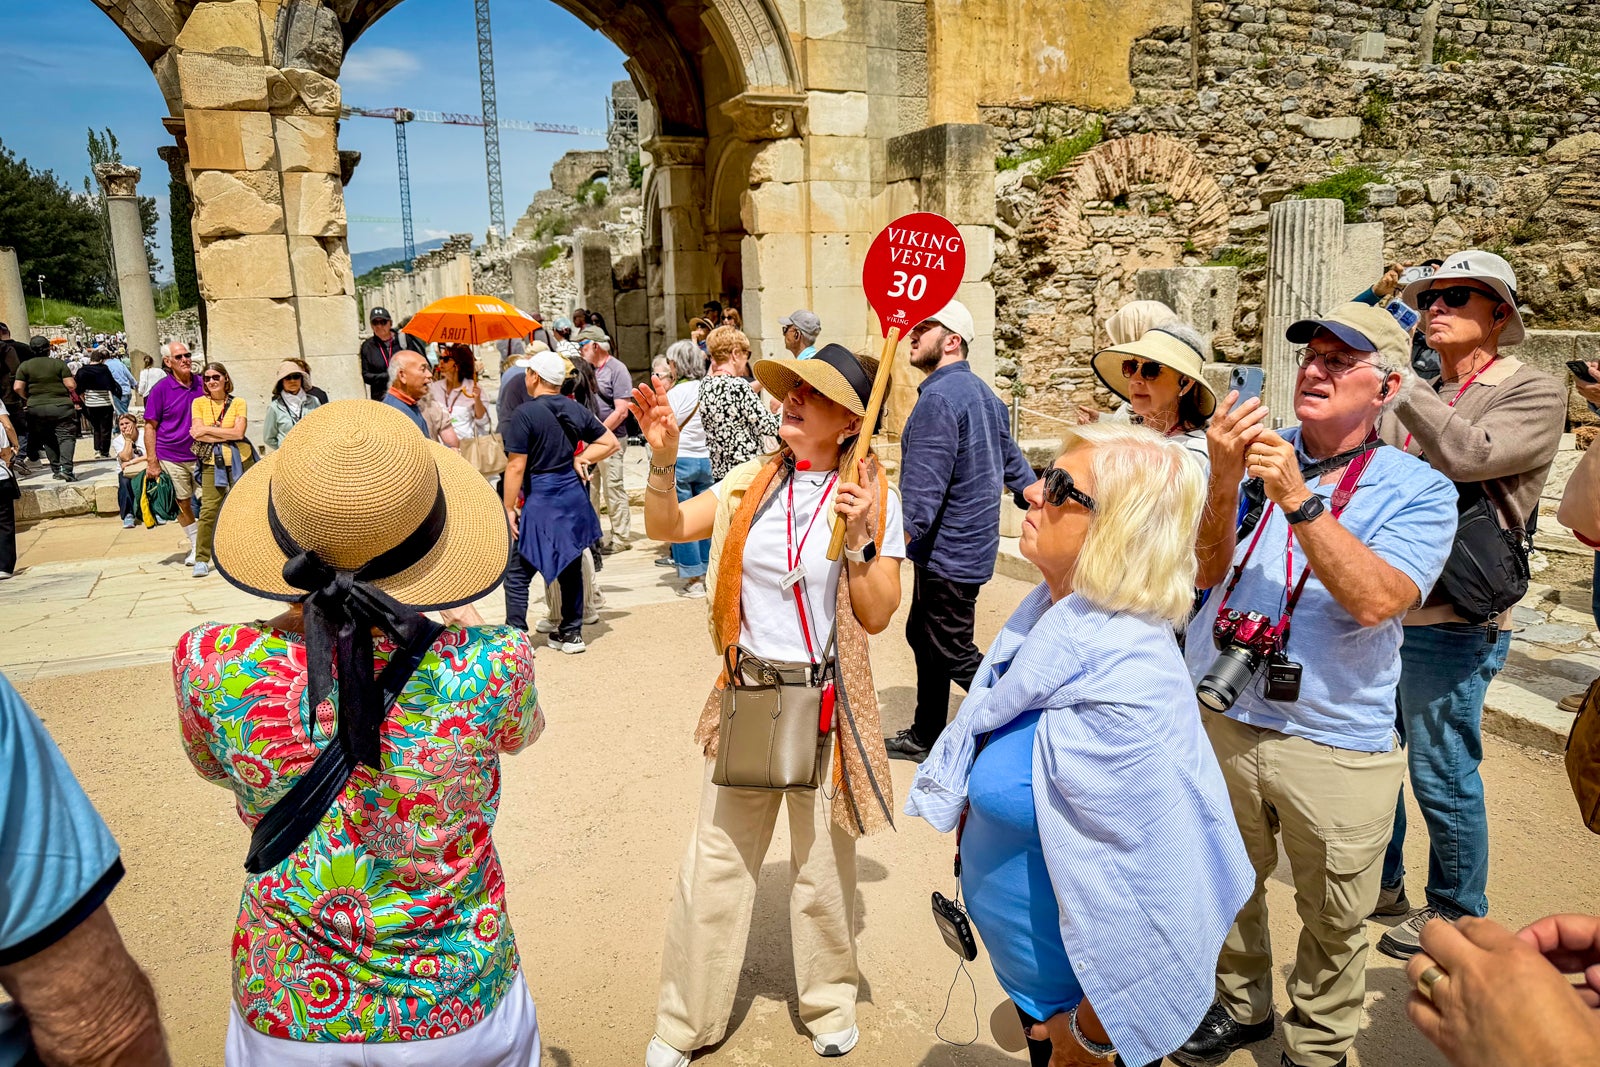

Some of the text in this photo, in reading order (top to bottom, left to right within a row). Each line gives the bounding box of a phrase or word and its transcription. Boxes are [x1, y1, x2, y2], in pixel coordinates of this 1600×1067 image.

[887, 227, 961, 253] VIKING
[890, 246, 946, 271] VESTA
[887, 270, 928, 301] 30
[475, 303, 507, 314] TURA
[886, 316, 909, 326] VIKING
